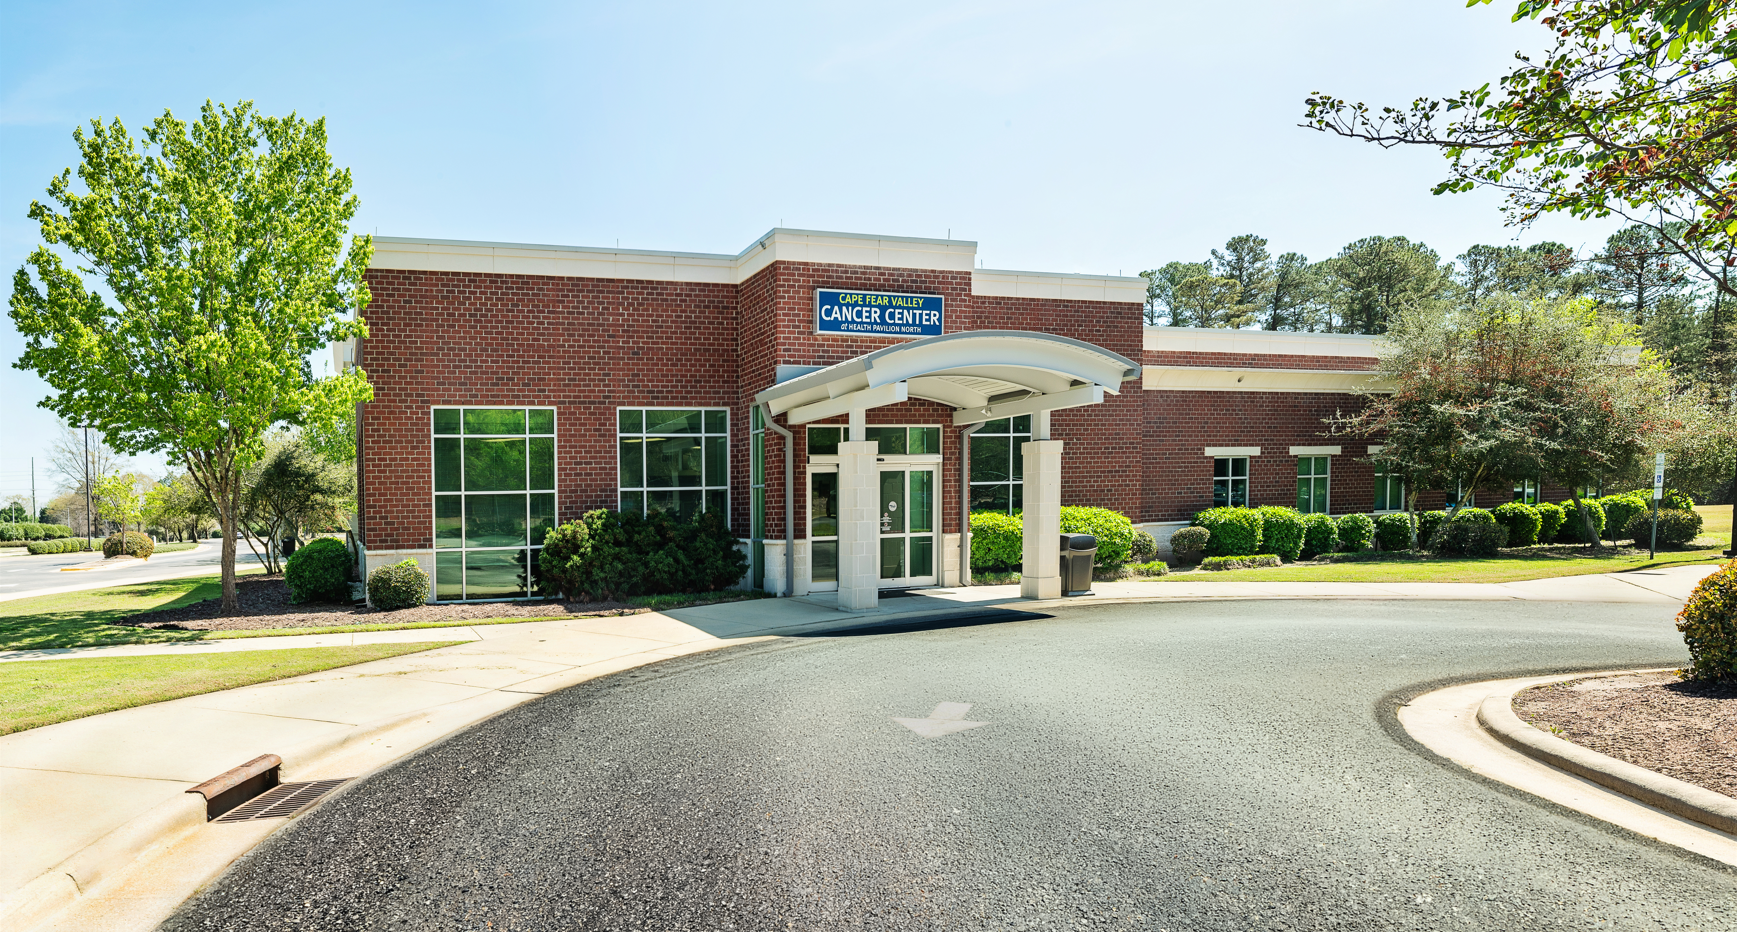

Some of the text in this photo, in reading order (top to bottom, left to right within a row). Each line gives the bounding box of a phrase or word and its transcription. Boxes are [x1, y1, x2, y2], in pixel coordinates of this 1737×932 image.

[839, 293, 924, 307] CAPE FEAR VALLEY
[821, 305, 939, 325] CANCER CENTER
[840, 322, 847, 330] at
[848, 323, 872, 331] HEALTH
[873, 324, 900, 332] PAVILION
